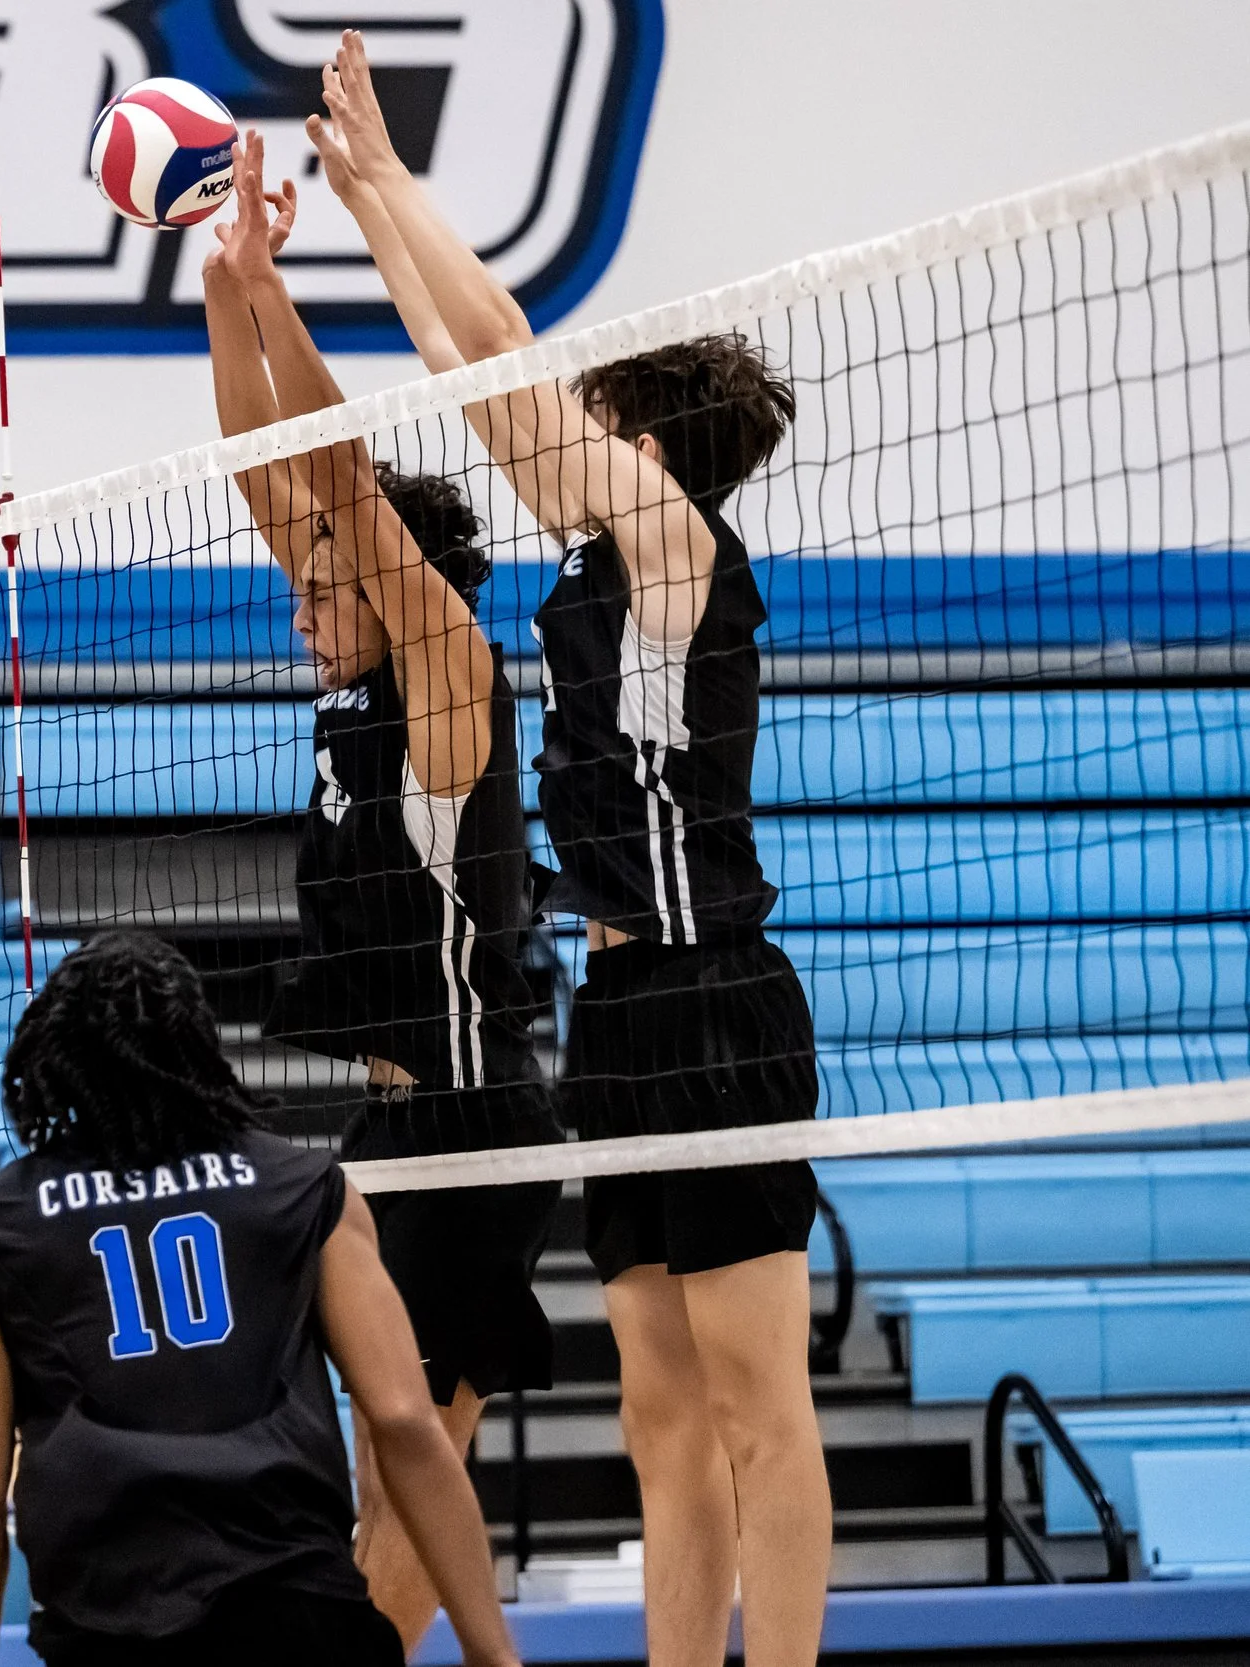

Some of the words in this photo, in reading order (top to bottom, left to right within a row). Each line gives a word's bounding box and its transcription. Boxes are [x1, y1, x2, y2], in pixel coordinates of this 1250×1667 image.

[201, 149, 232, 169] molte
[197, 175, 235, 199] NCA
[38, 1152, 257, 1217] CORSAIRS
[89, 1211, 235, 1361] 10
